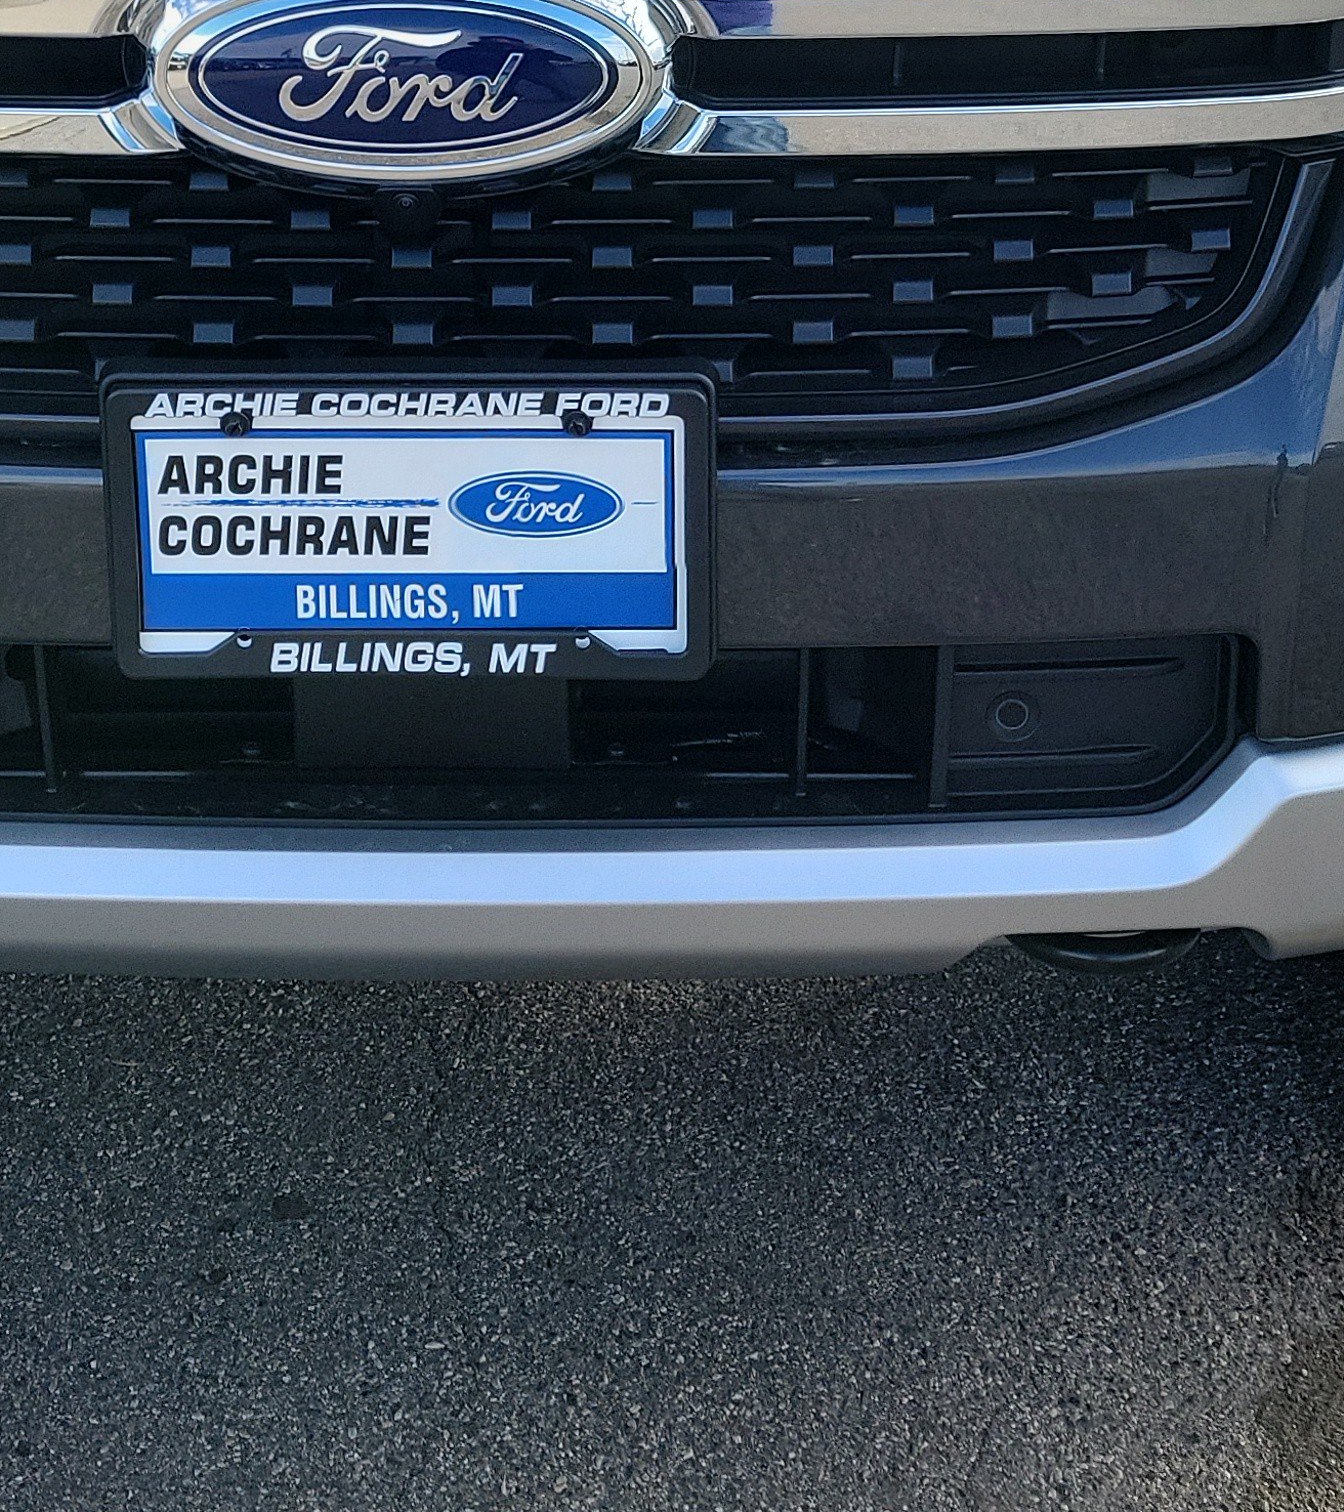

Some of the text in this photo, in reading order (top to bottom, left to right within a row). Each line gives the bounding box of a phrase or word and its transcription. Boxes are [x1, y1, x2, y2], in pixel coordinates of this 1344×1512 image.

[278, 24, 524, 123] Ford
[145, 392, 670, 418] ARCHIE COCHRANE FORD
[157, 454, 344, 496] ARCHIE
[485, 481, 586, 525] Ford
[157, 514, 432, 557] COCHRANE
[295, 583, 524, 625] BILLINGS, MT
[270, 641, 558, 677] BILLINGS, MT
